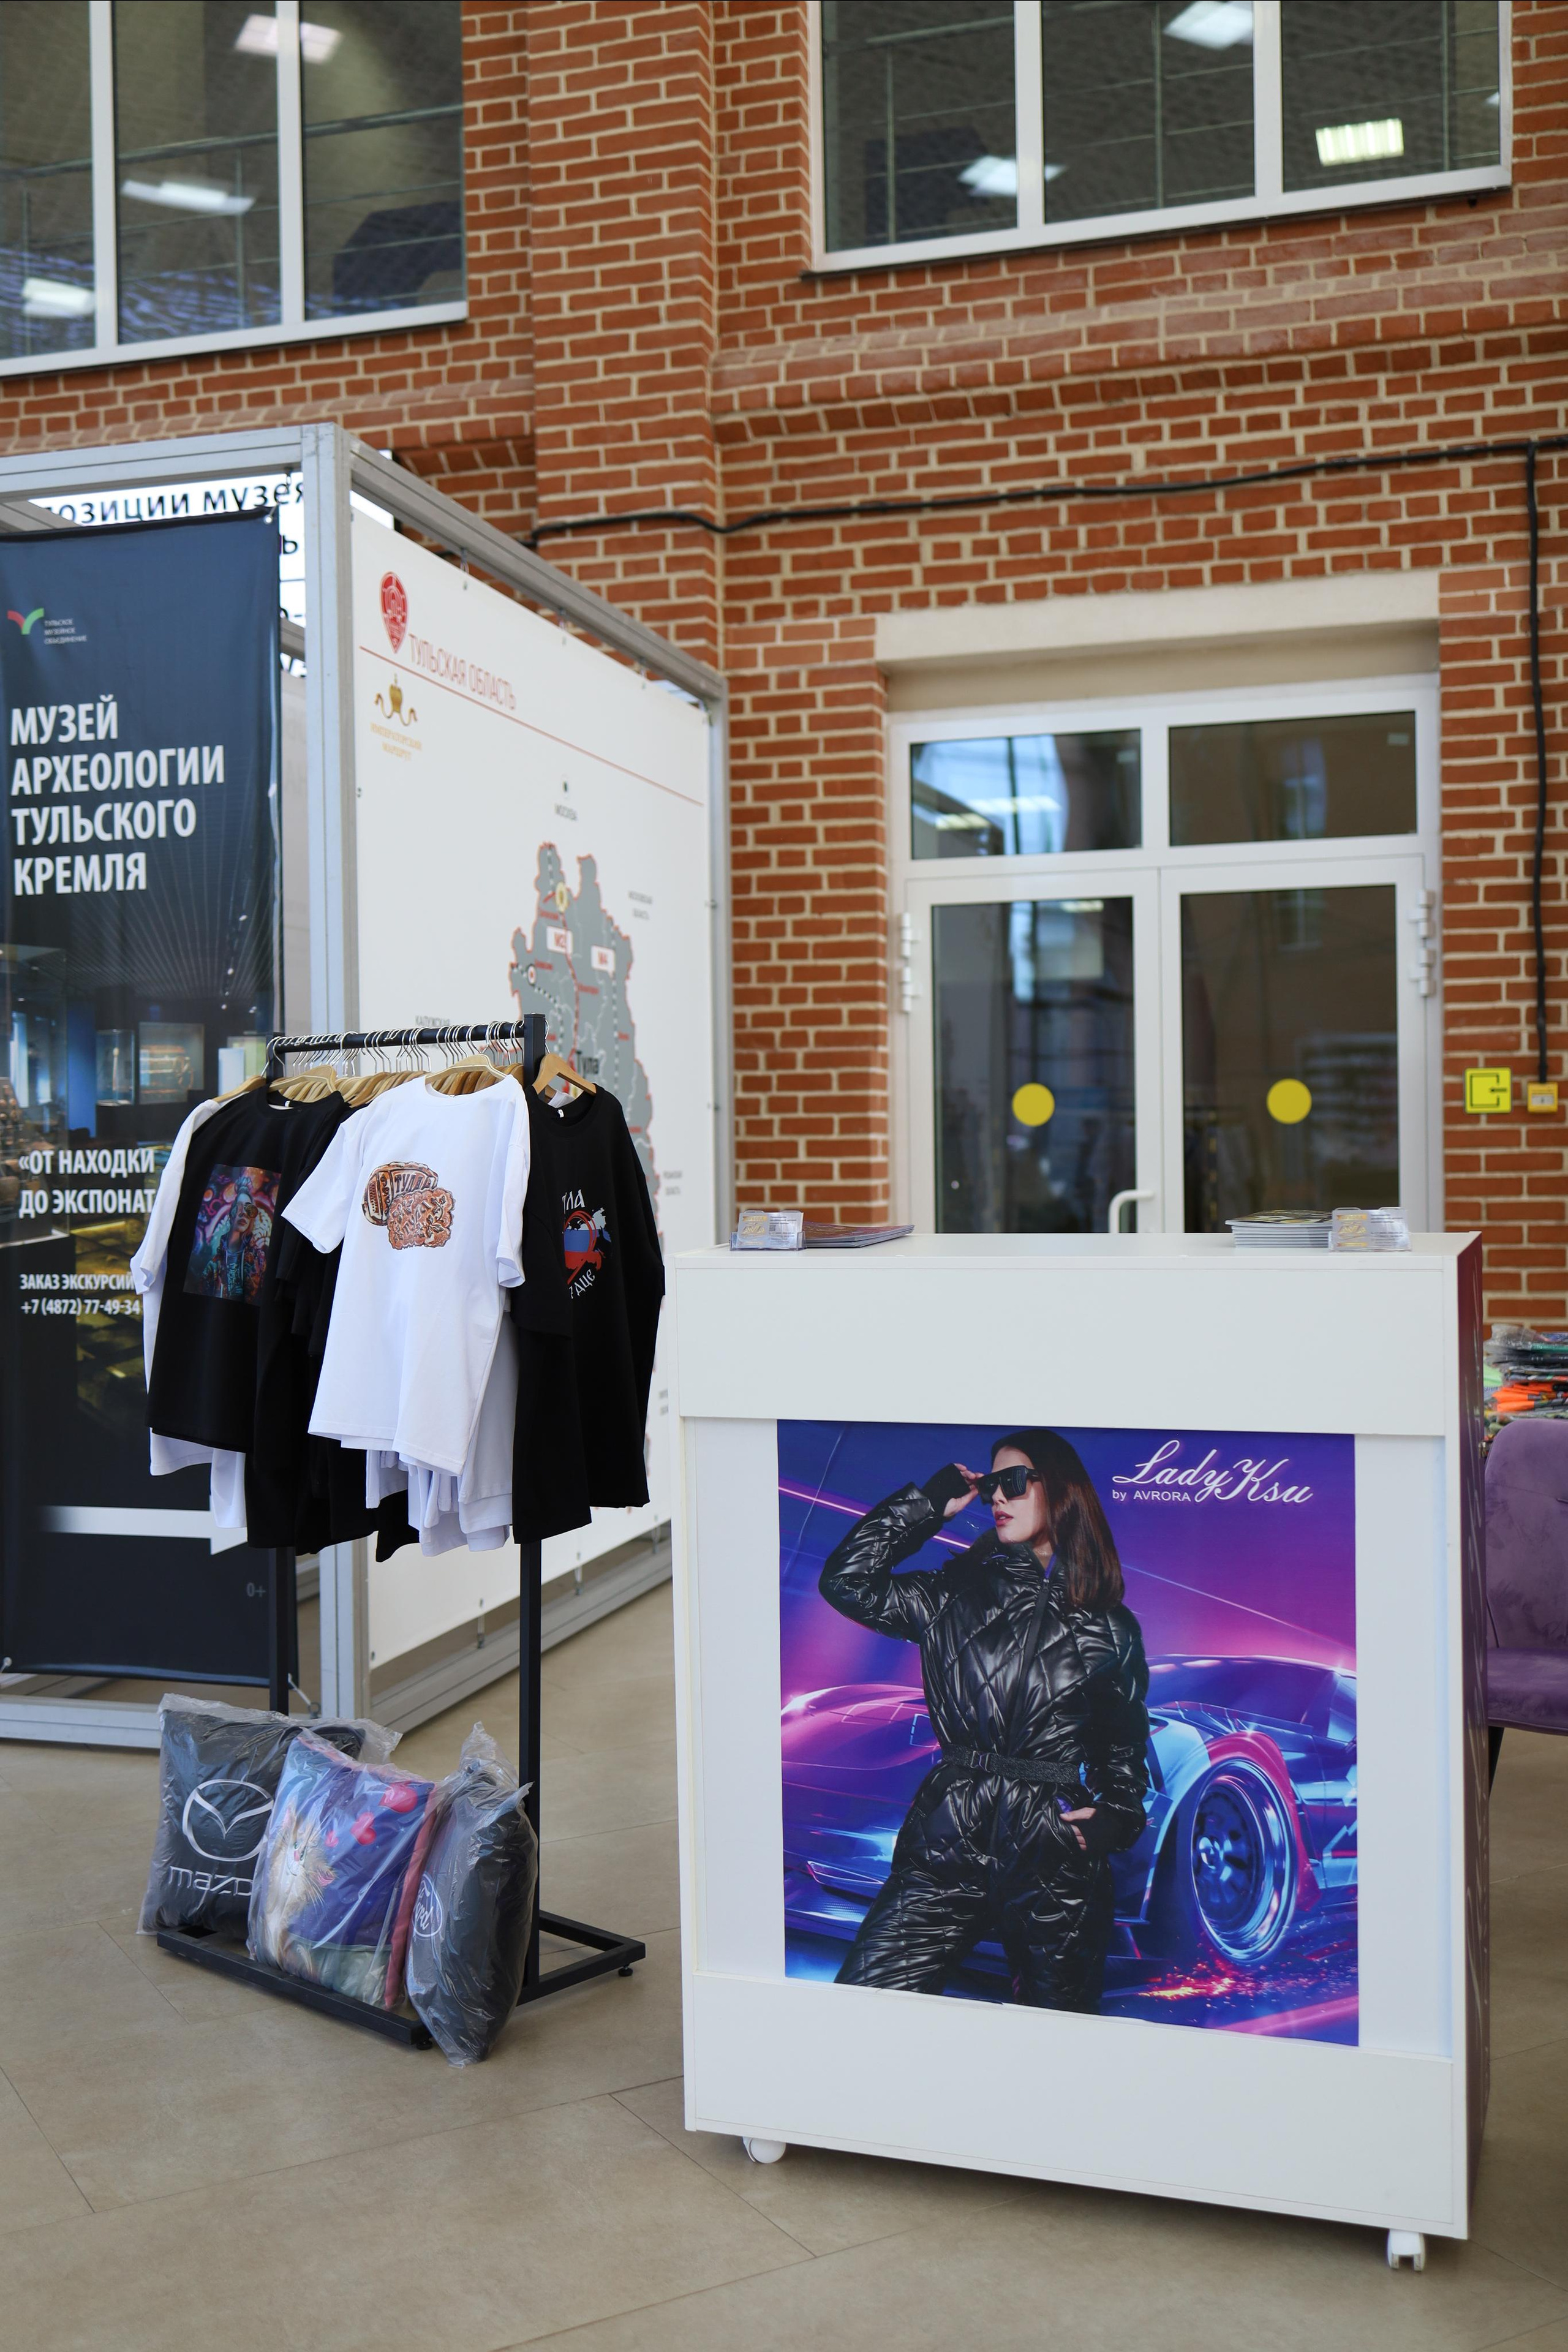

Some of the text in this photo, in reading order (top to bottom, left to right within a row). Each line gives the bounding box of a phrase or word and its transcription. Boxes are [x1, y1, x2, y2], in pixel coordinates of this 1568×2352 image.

[45, 494, 189, 523] озиции
[409, 633, 516, 710] ТУЛЬСКАЯ ОБЛАСТЬ
[11, 694, 118, 745] МУЗЕЙ
[11, 745, 224, 796] АРХЕОЛОГИИ
[12, 798, 196, 846] ТУЛЬСКОГО
[15, 852, 146, 895] КРЕМЛЯ
[19, 1149, 154, 1178] «ОТ НАХОДКИ
[19, 1189, 156, 1219] ДО ЭКСПОНАТ
[20, 1272, 135, 1290] ЗАКАЗ ЭКСКУРСИЙ
[21, 1297, 140, 1316] +7 (4872) 77-49-34
[1112, 1490, 1191, 1502] by AVRORA
[246, 1582, 266, 1597] 0+
